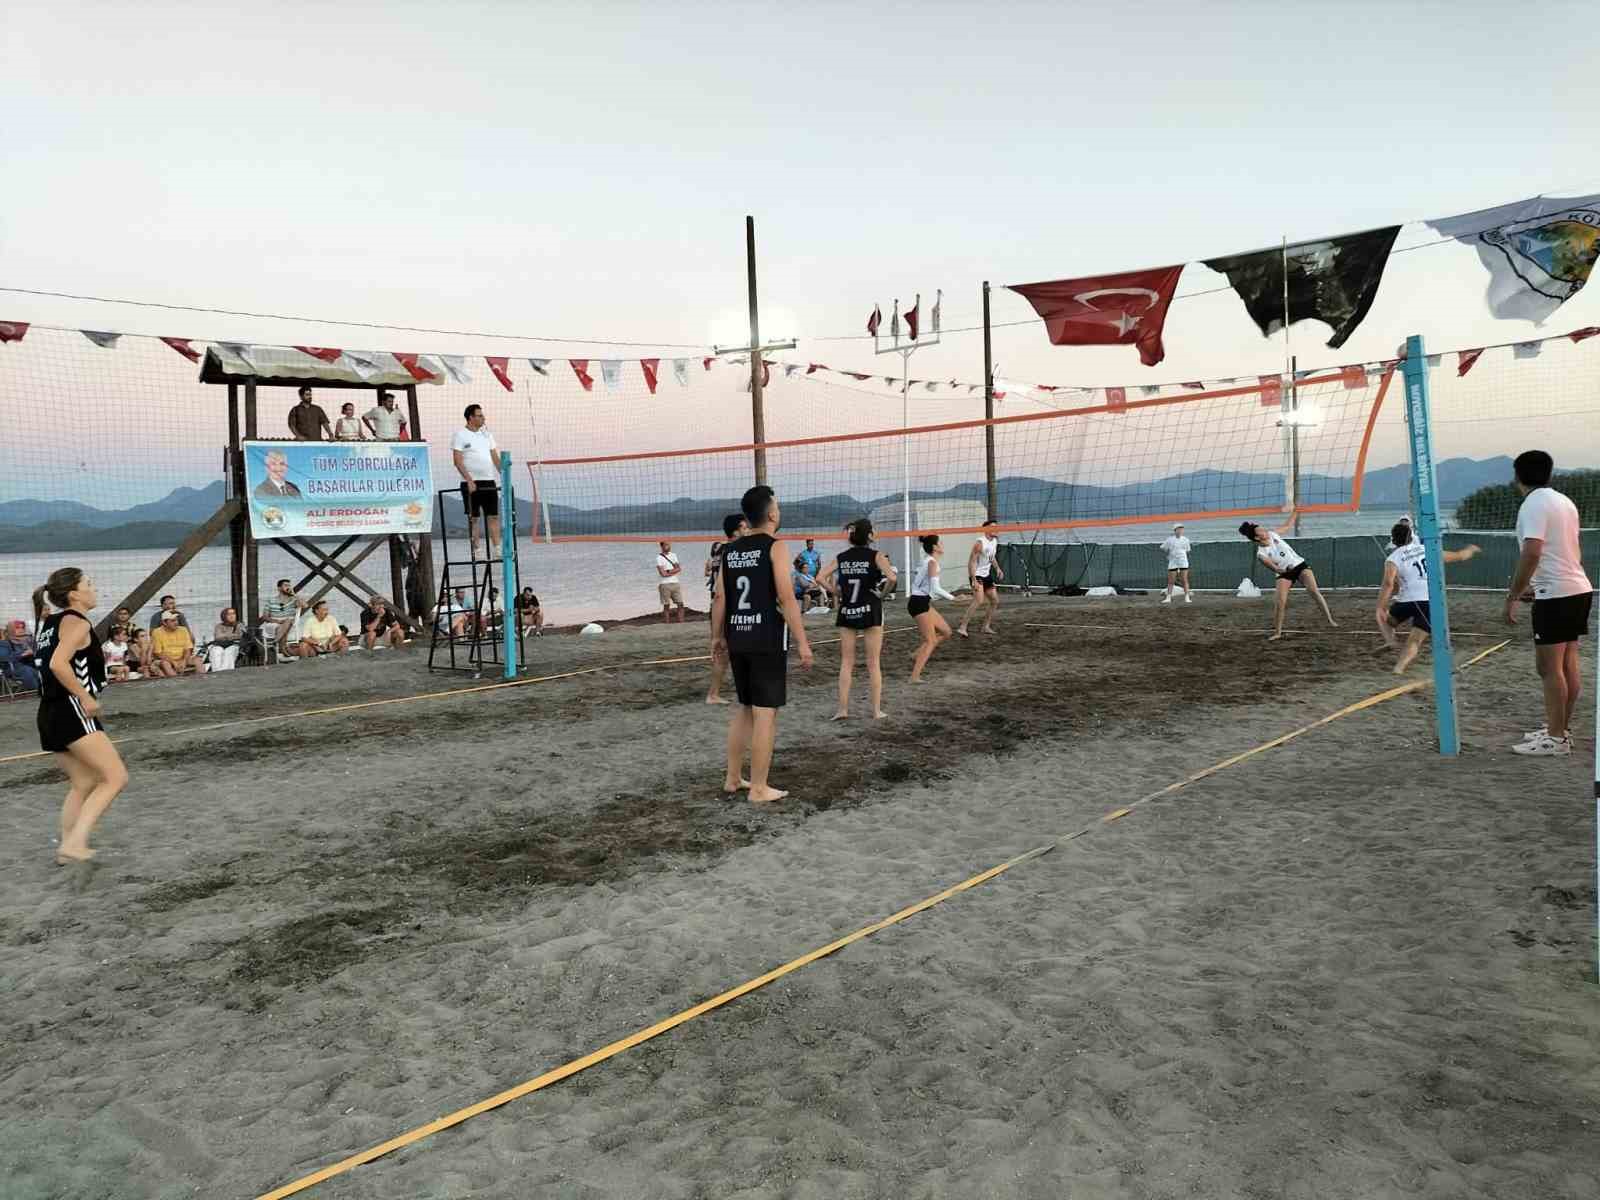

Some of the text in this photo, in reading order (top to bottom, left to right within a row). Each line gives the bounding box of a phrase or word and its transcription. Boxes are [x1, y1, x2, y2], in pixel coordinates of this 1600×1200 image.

[341, 457, 417, 472] SPORCULARA
[736, 575, 751, 610] 2
[847, 578, 860, 604] 7
